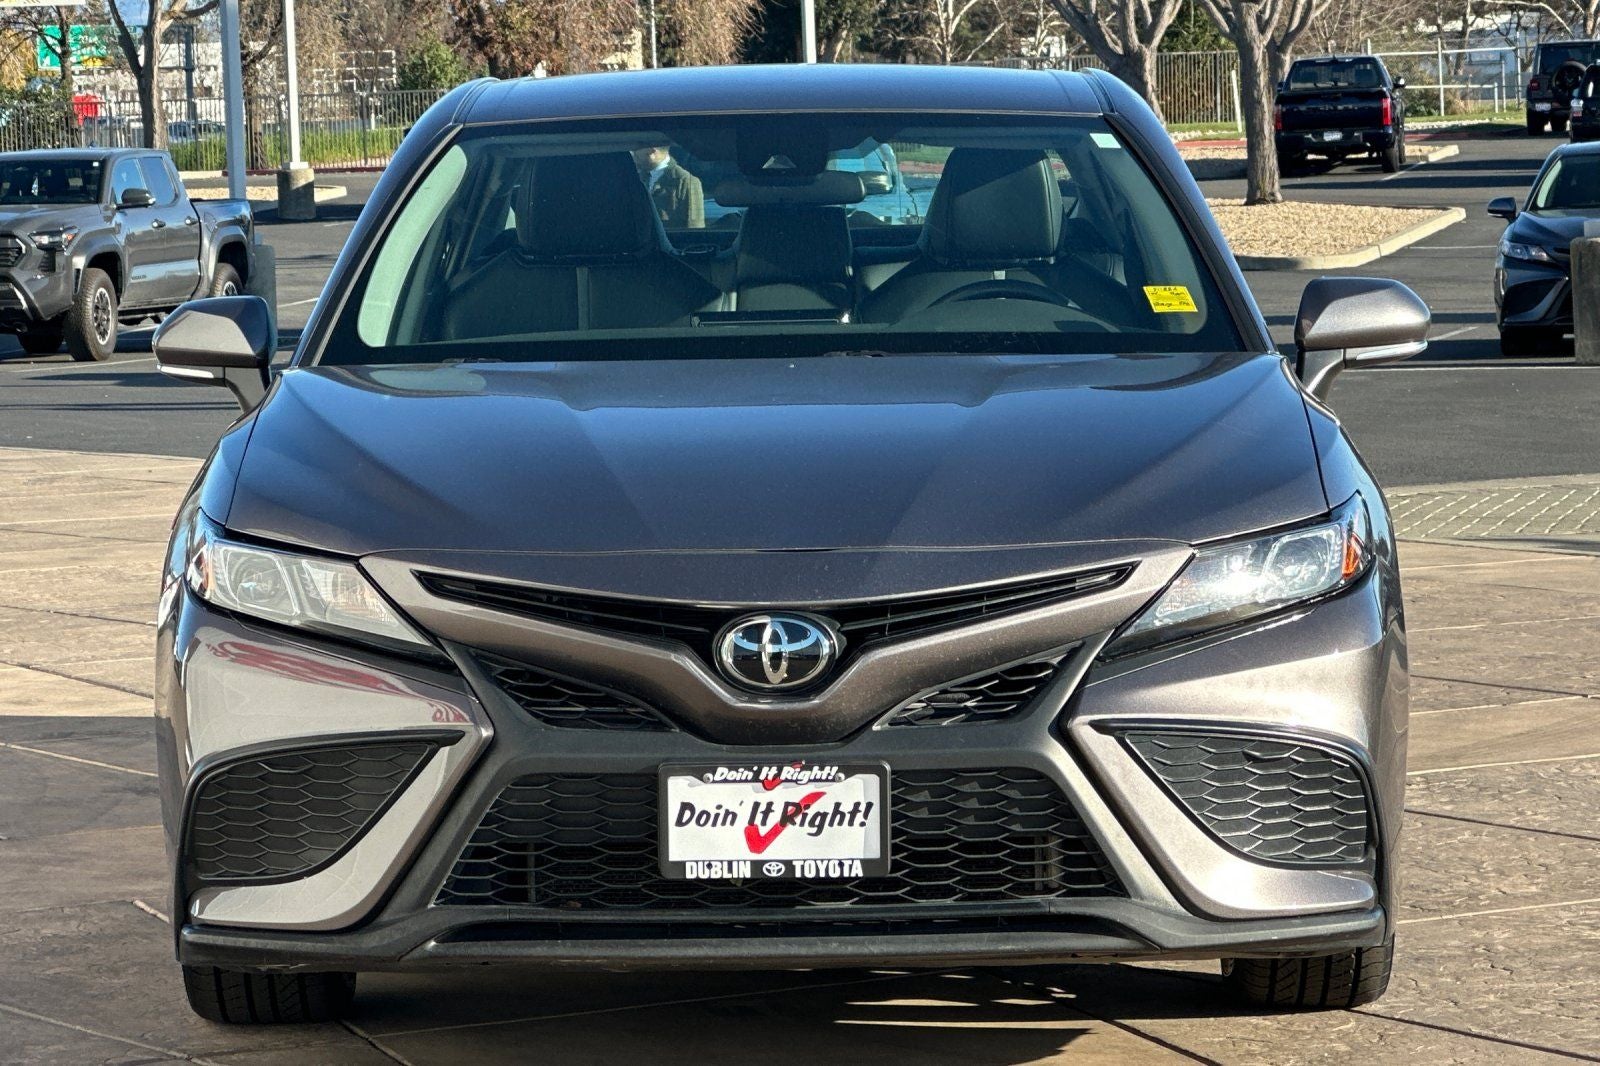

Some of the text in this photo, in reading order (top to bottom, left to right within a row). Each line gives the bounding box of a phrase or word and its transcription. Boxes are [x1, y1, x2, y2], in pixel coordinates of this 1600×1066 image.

[713, 766, 839, 784] Doin' It Right!
[674, 801, 875, 837] Doin' It Right!
[685, 860, 864, 879] DUBLIN TOYOTA
